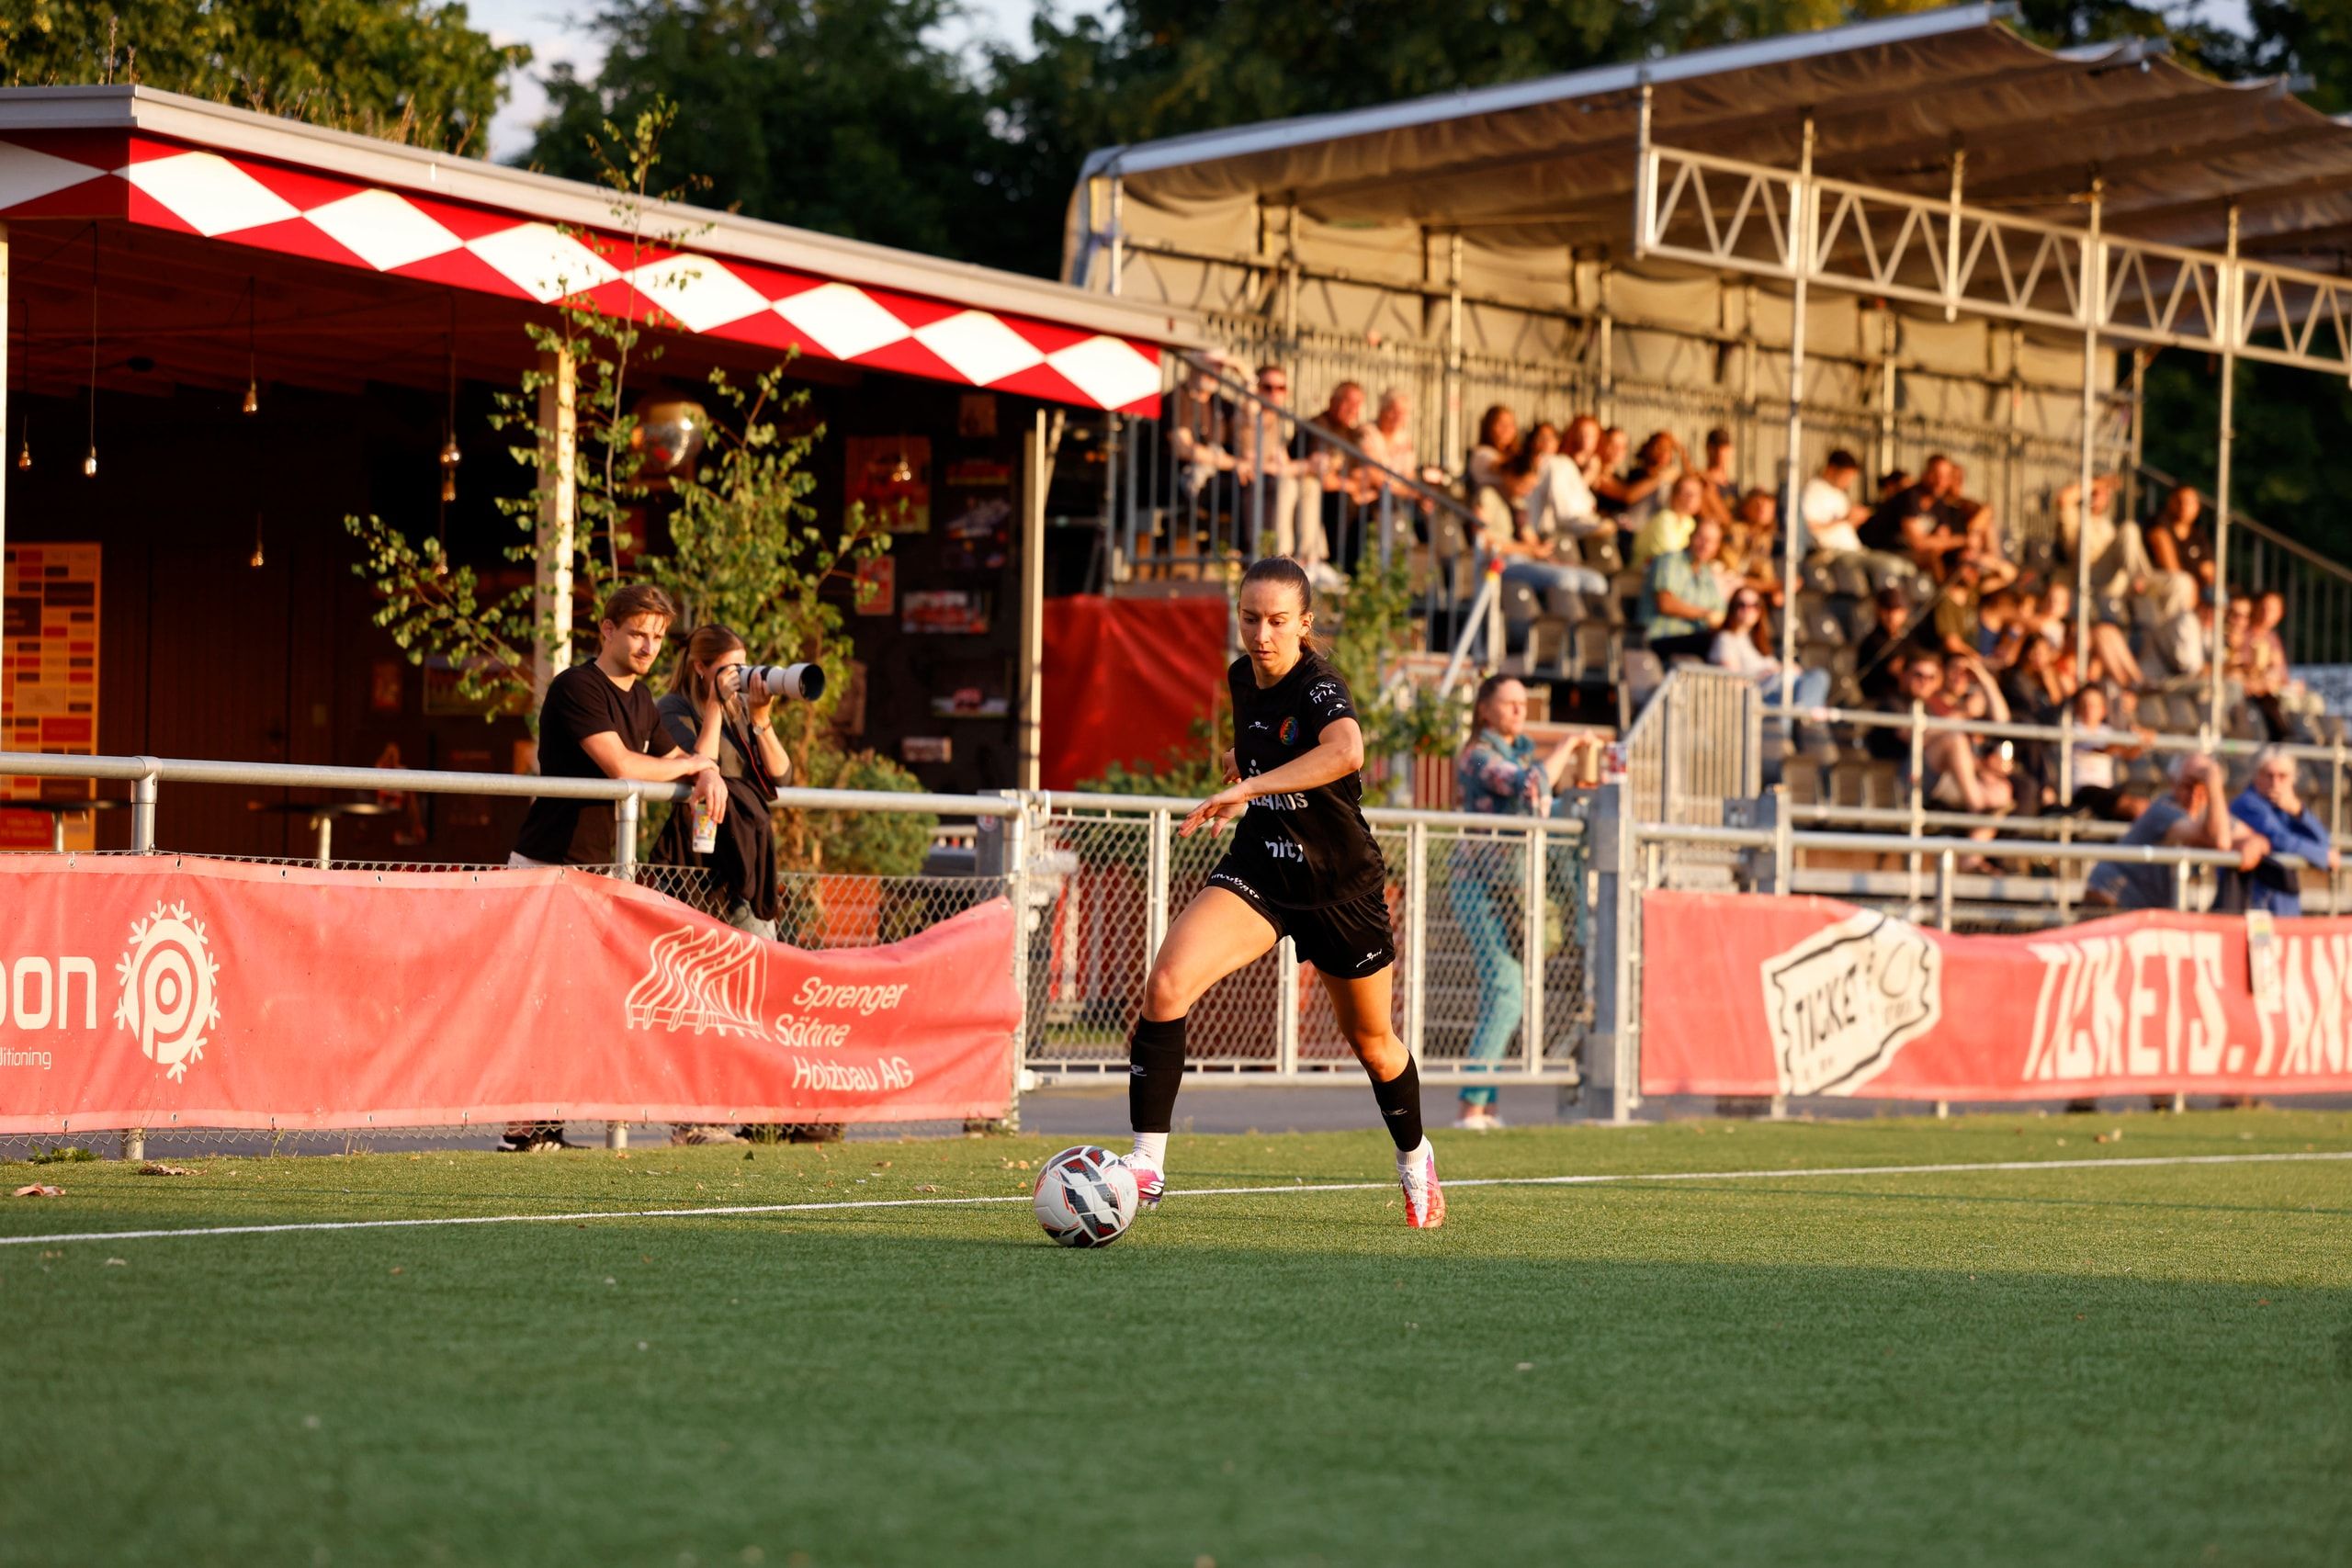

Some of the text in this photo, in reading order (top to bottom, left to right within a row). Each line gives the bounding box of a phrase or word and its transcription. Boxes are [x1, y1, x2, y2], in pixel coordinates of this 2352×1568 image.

[0, 956, 97, 1030] on
[793, 976, 909, 1016] Sprenger
[1794, 964, 1859, 1057] TICKET
[2253, 934, 2352, 1077] FAN
[775, 1013, 852, 1047] Söhne
[791, 1055, 914, 1091] Holzbau AG
